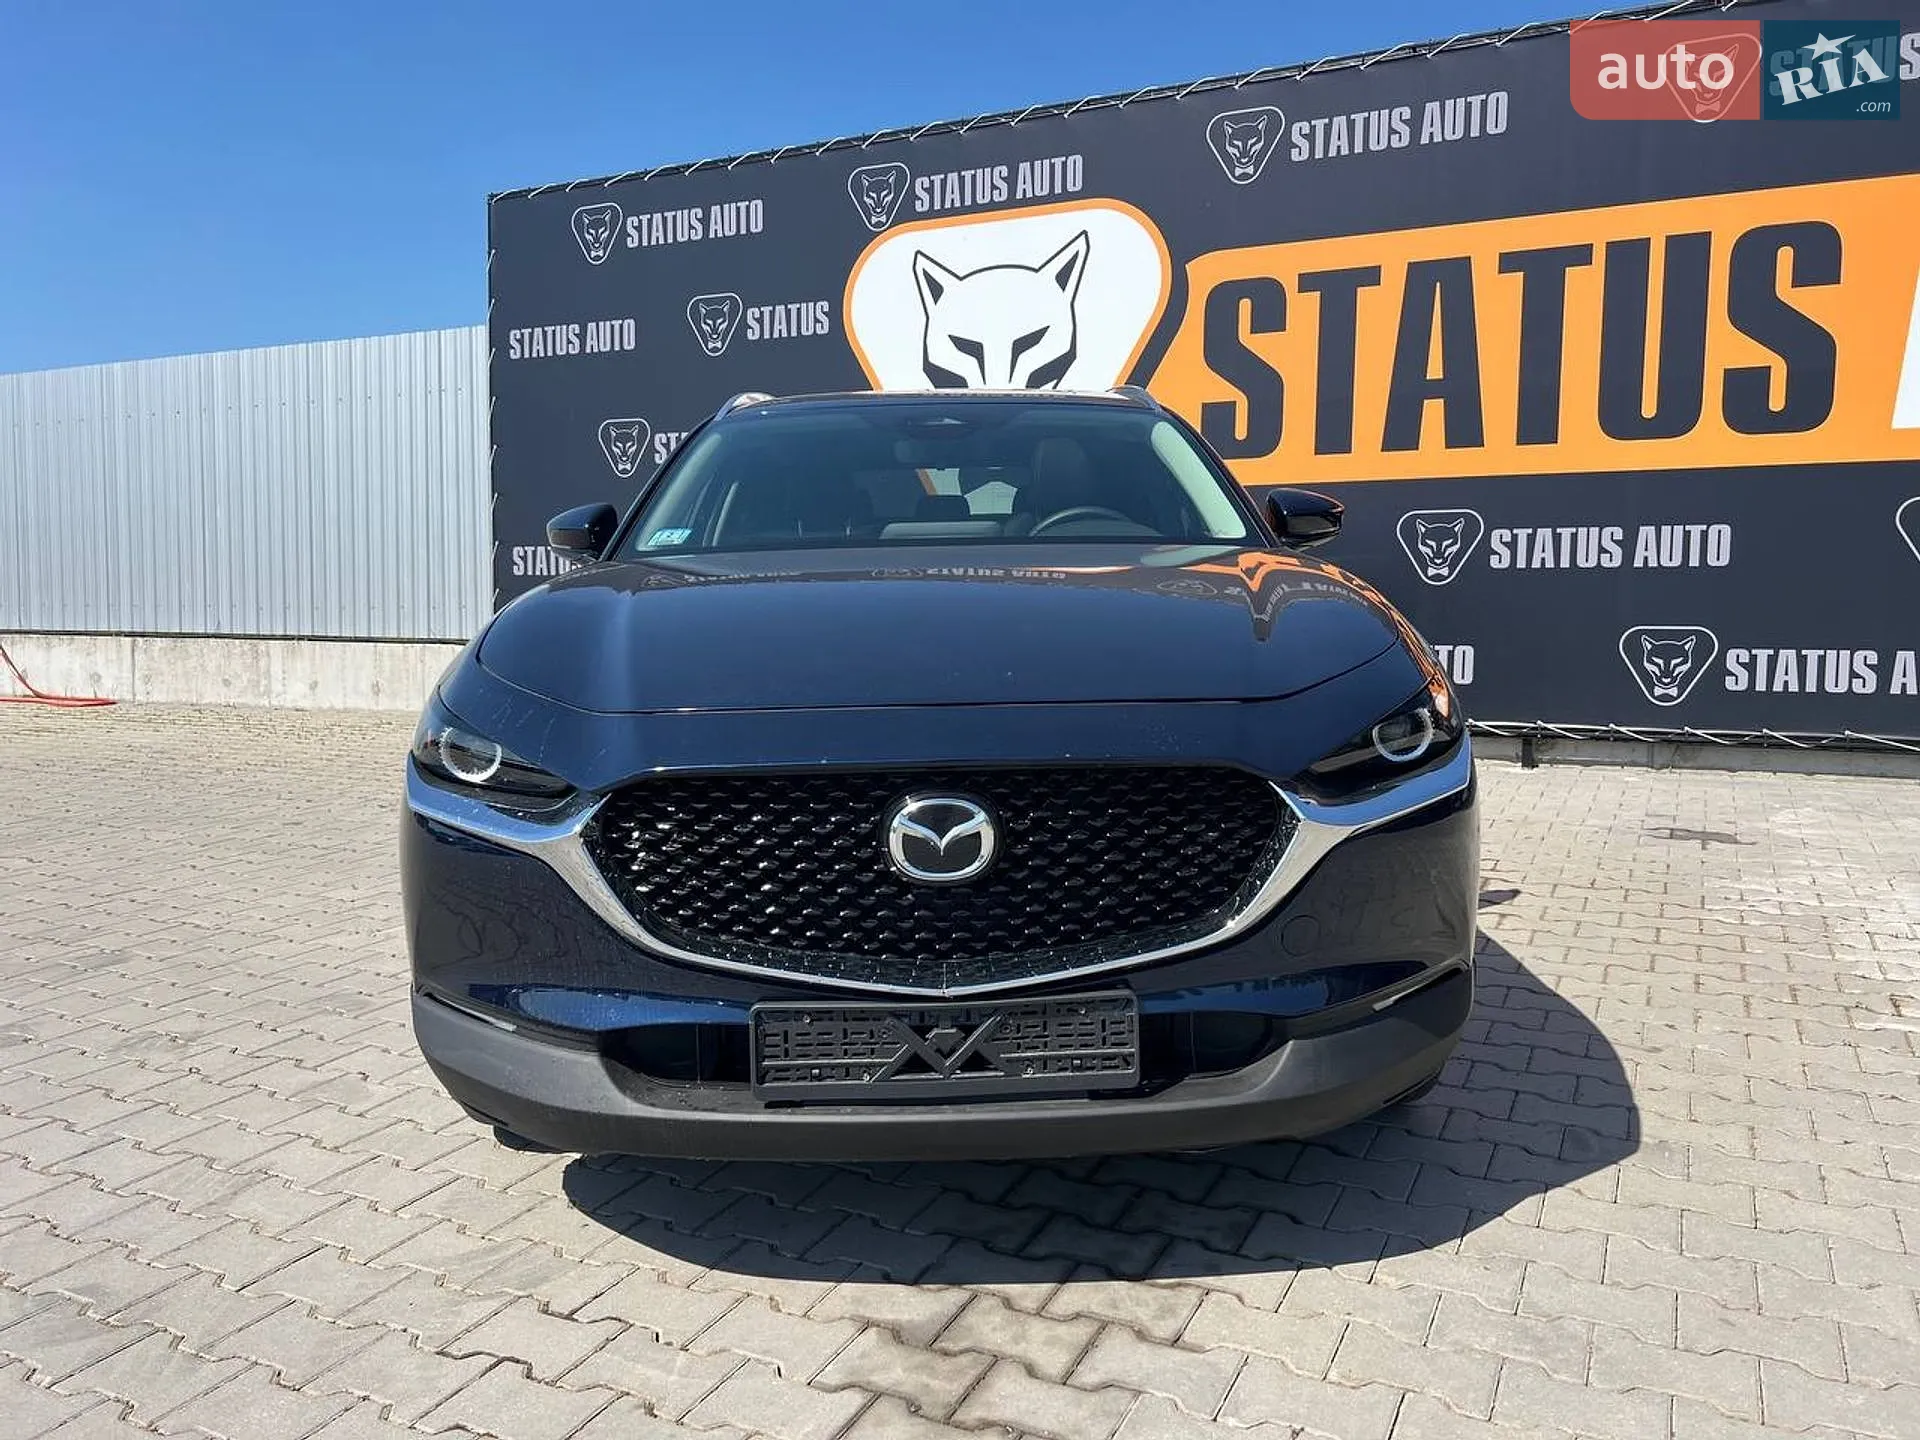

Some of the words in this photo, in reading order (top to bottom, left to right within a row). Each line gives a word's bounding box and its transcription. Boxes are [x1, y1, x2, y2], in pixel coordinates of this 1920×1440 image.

[1291, 105, 1411, 161] STATUS
[1420, 91, 1509, 144] AUTO
[914, 165, 1009, 212] STATUS
[1015, 154, 1083, 199] AUTO
[626, 205, 703, 249] STATUS
[708, 199, 764, 239] AUTO
[509, 323, 581, 360] STATUS
[585, 318, 636, 354] AUTO
[746, 300, 830, 342] STATUS
[1200, 220, 1843, 460] STATUS
[654, 431, 690, 464] ST
[1489, 525, 1624, 569] STATUS
[1633, 523, 1732, 568] AUTO
[1430, 644, 1475, 685] TO
[1724, 648, 1879, 695] STATUS
